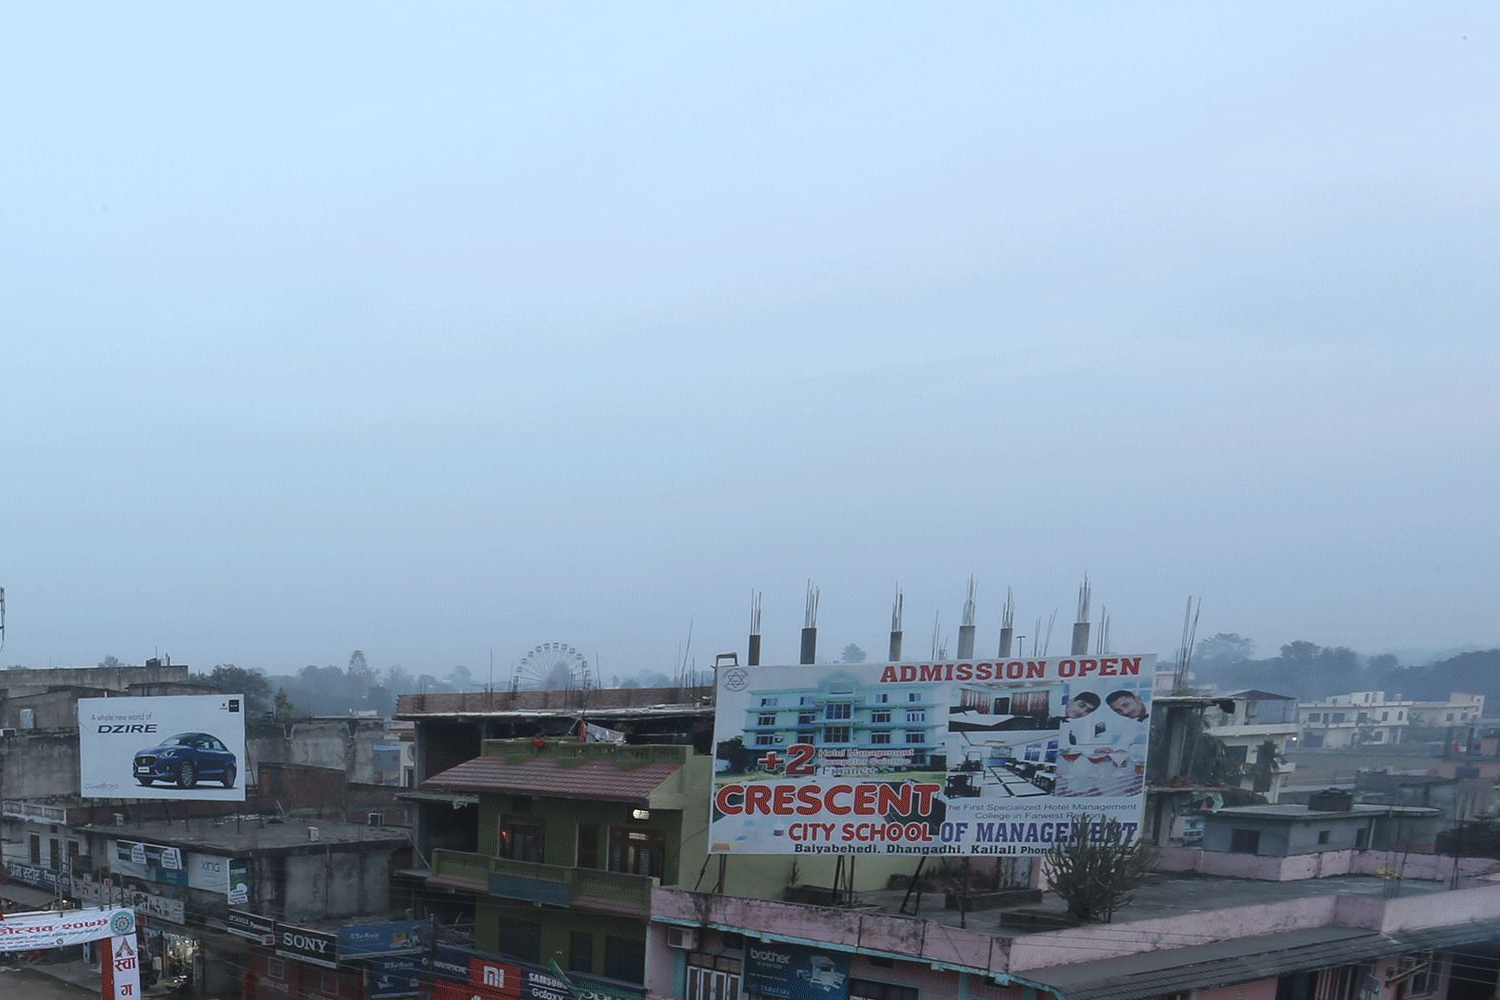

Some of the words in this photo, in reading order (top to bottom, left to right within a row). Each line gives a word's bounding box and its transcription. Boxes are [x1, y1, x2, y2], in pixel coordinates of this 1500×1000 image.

[880, 660, 1046, 683] ADMISSION
[1057, 657, 1142, 678] OPEN
[97, 724, 158, 733] DZIRE
[715, 783, 940, 816] CRESCENT
[788, 823, 835, 841] CITY
[840, 823, 933, 841] SCHOOL
[941, 822, 968, 842] OF
[971, 844, 1016, 855] Kailali
[283, 931, 328, 953] SONY
[750, 947, 790, 964] brother
